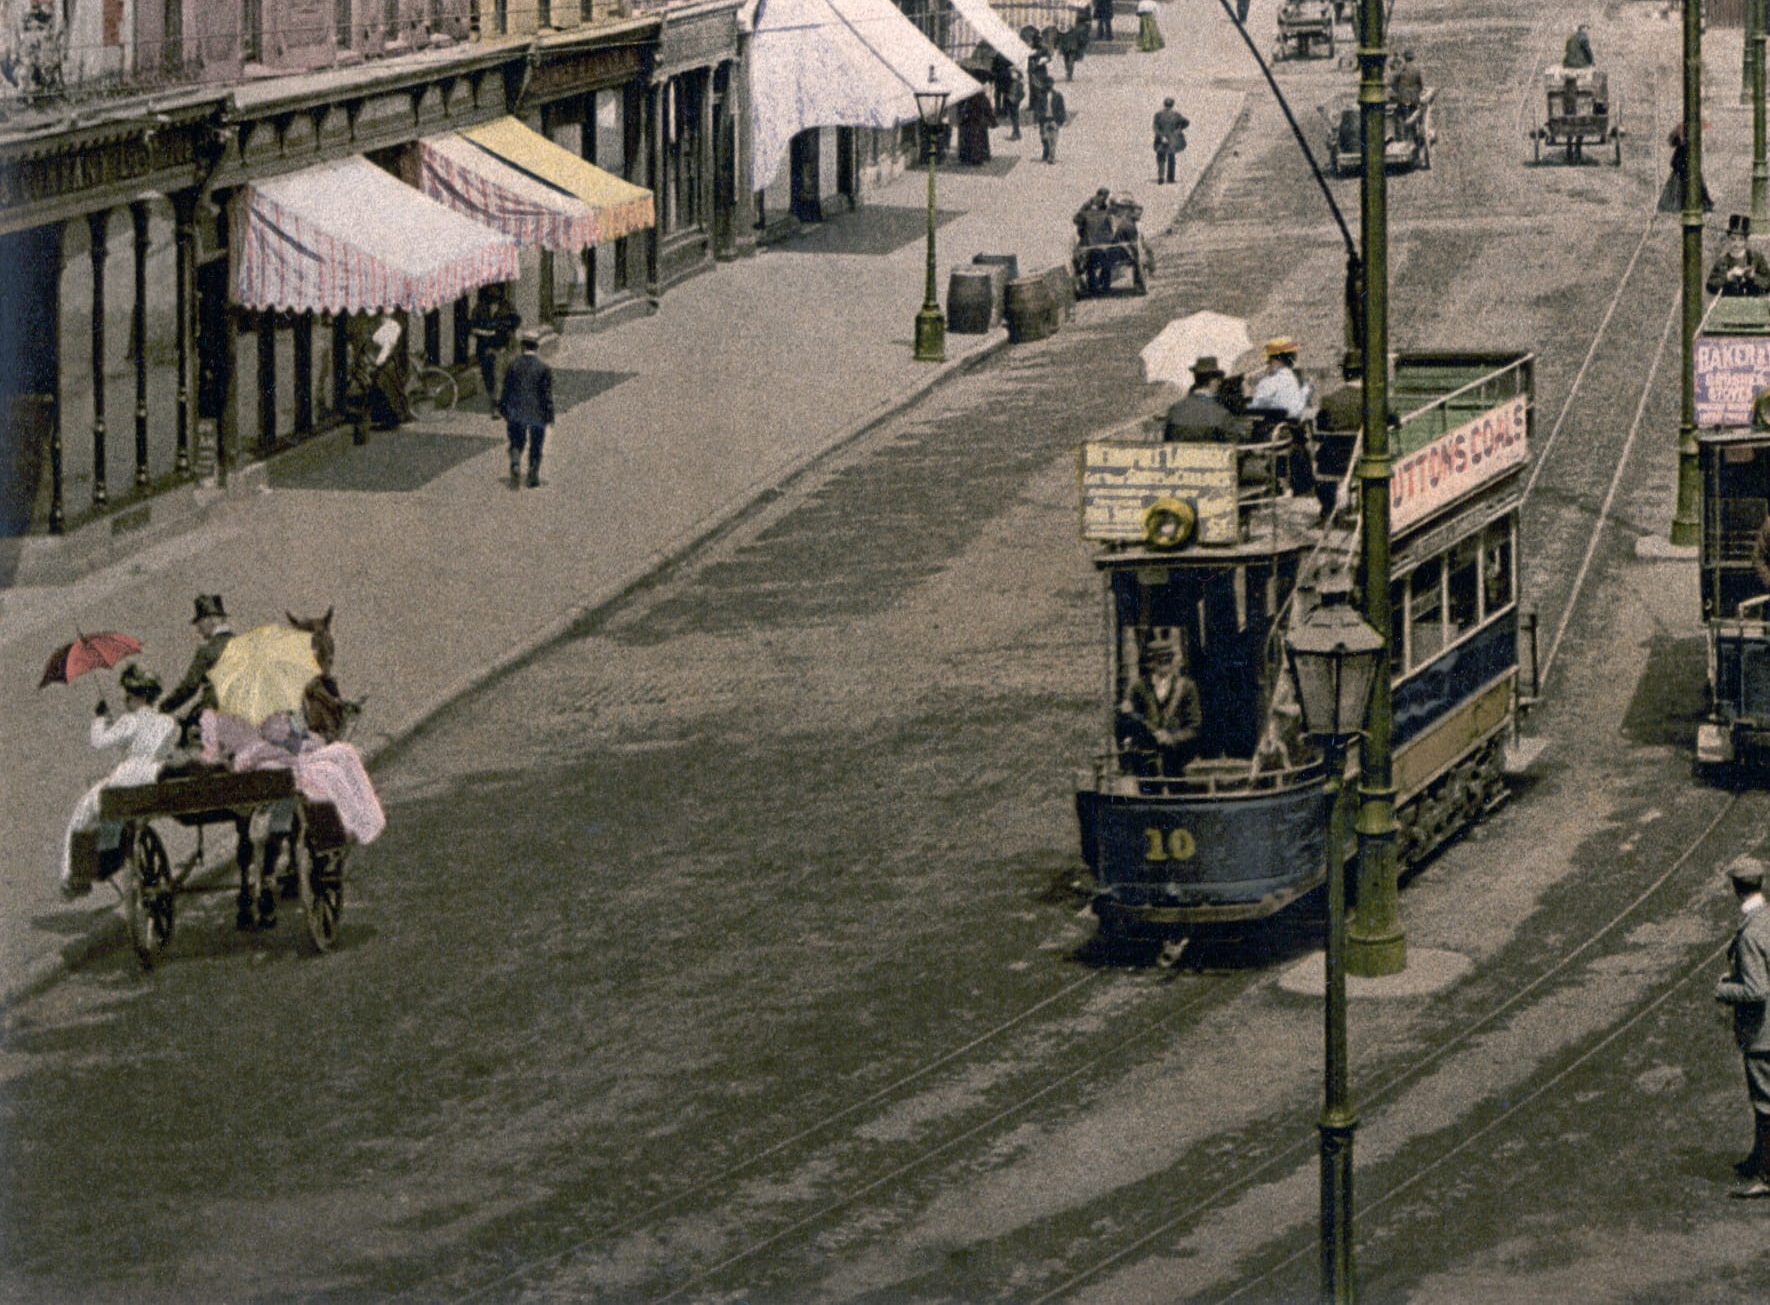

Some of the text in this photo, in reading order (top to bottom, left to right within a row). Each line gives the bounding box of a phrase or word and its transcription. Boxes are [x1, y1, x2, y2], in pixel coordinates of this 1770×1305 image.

[1698, 344, 1754, 372] BAKER
[1470, 404, 1524, 464] COALS
[1145, 827, 1196, 861] 10
